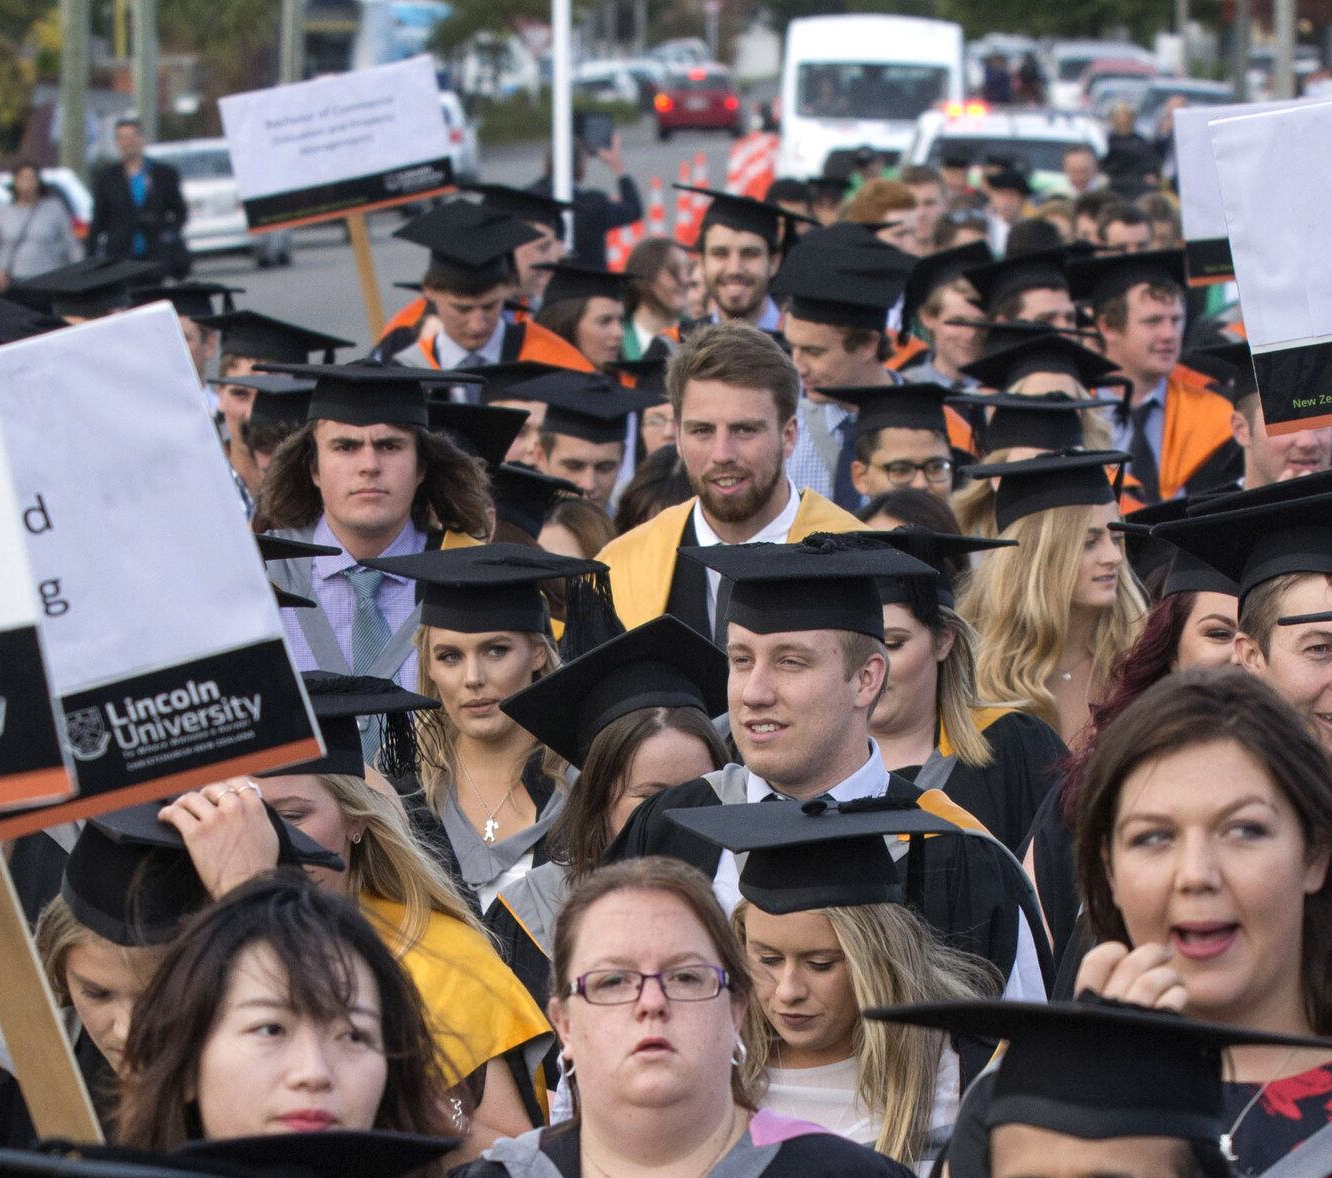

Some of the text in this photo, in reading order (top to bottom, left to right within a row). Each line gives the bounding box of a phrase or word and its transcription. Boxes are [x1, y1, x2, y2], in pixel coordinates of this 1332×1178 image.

[1292, 396, 1317, 409] New
[105, 679, 221, 728] Lincoln
[112, 692, 263, 751] University
